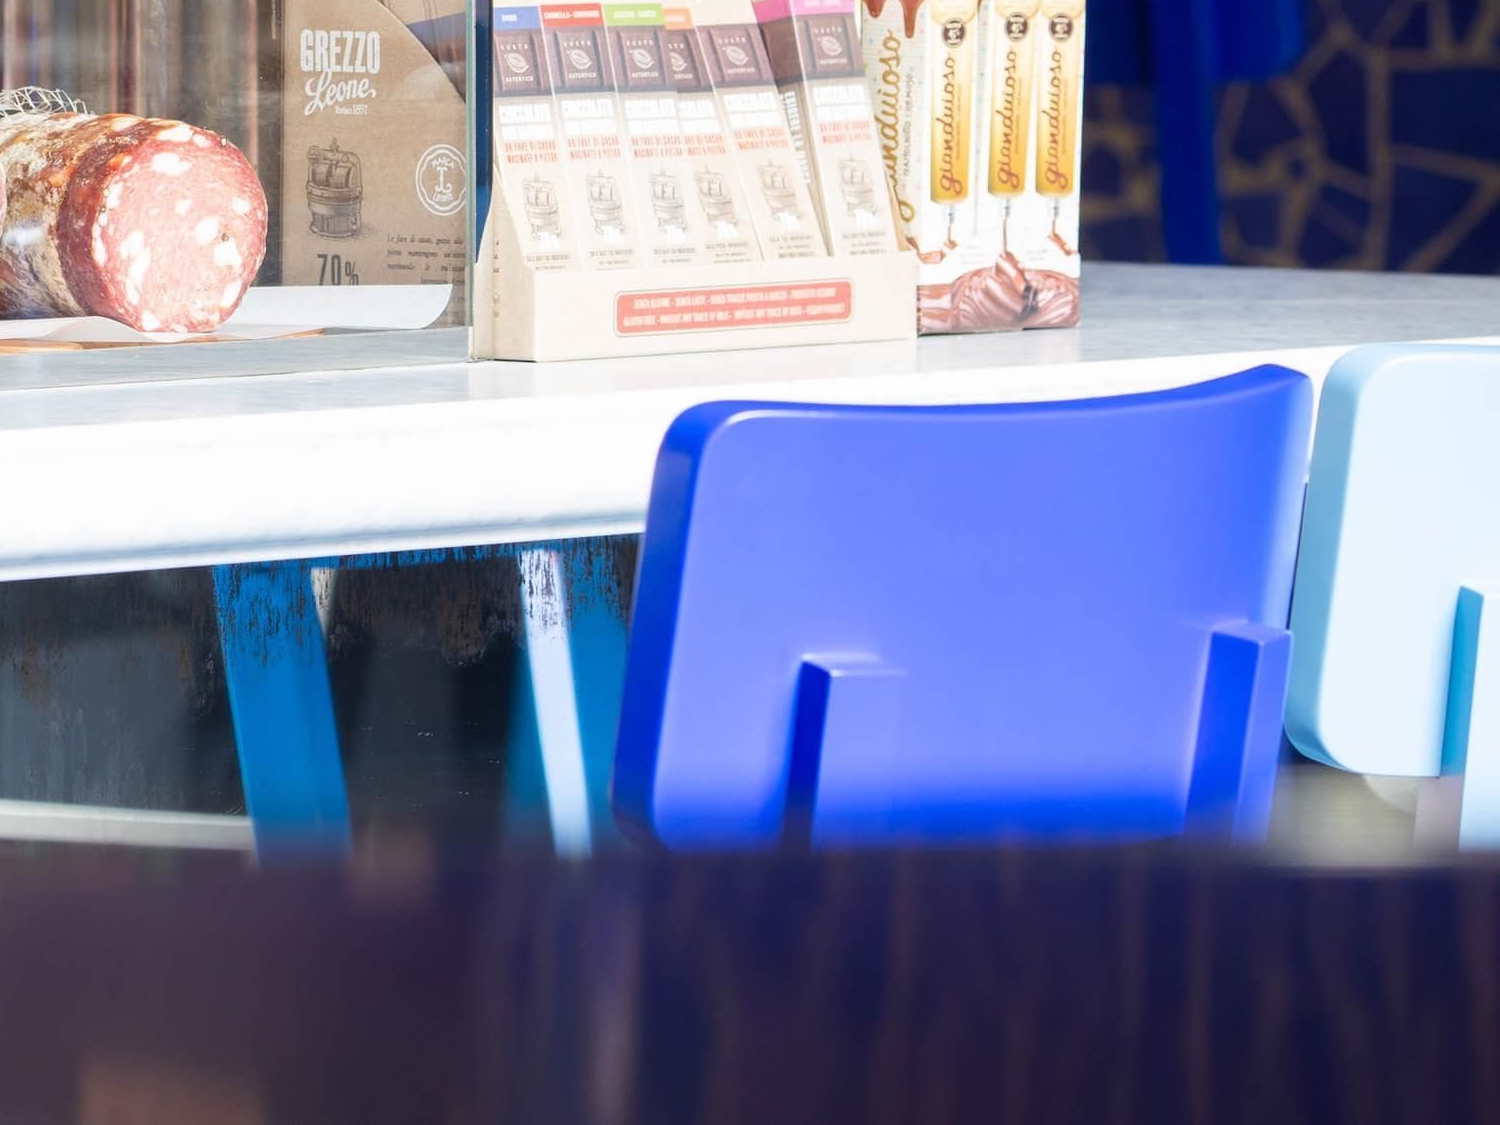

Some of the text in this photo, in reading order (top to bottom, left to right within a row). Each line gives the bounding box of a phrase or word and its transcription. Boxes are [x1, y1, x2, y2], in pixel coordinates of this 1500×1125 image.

[300, 29, 380, 74] GREZZO
[304, 68, 376, 115] Leone
[936, 50, 963, 196] gianduioso
[995, 46, 1021, 190] gianduioso
[1041, 47, 1067, 190] gianduioso
[317, 253, 359, 286] 70%
